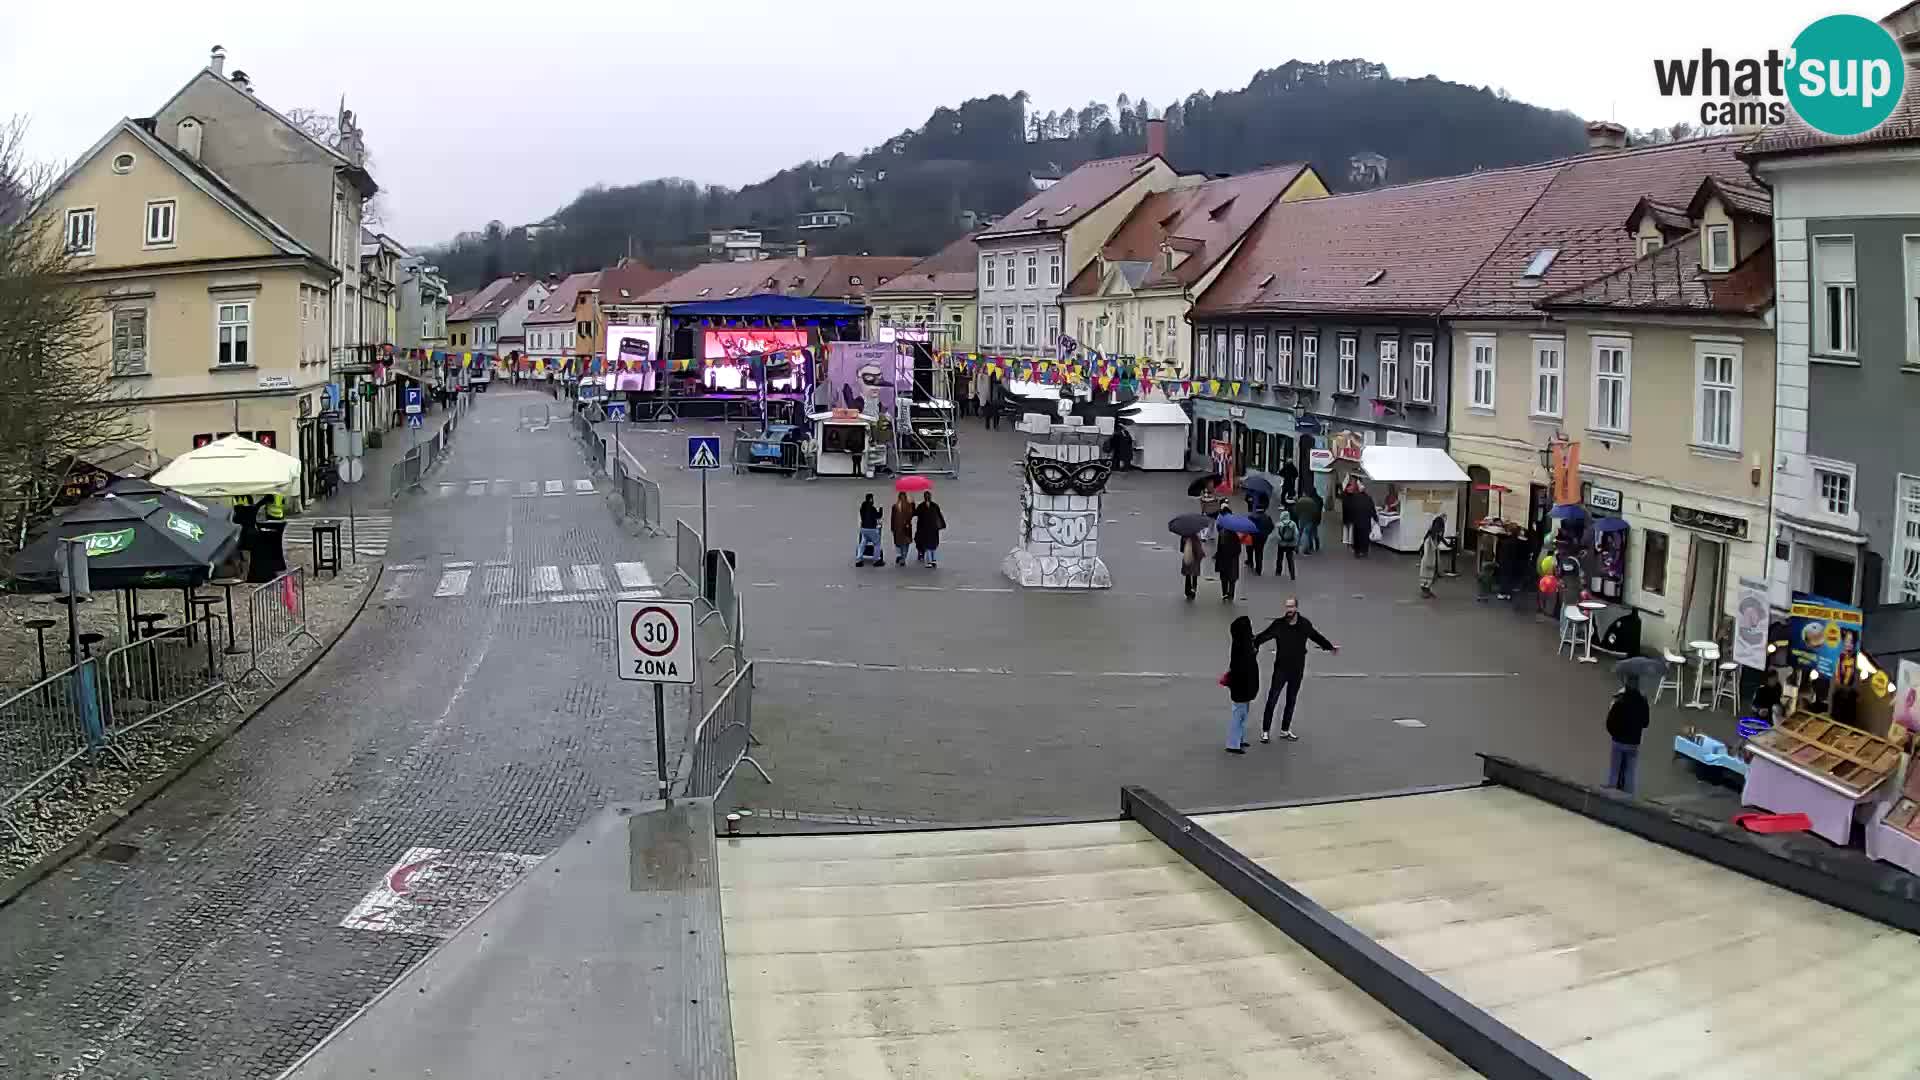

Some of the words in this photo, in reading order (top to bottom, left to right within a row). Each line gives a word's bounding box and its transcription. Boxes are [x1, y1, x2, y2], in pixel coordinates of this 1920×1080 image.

[409, 391, 417, 403] P
[643, 622, 667, 643] 30
[634, 659, 677, 676] ZONA
